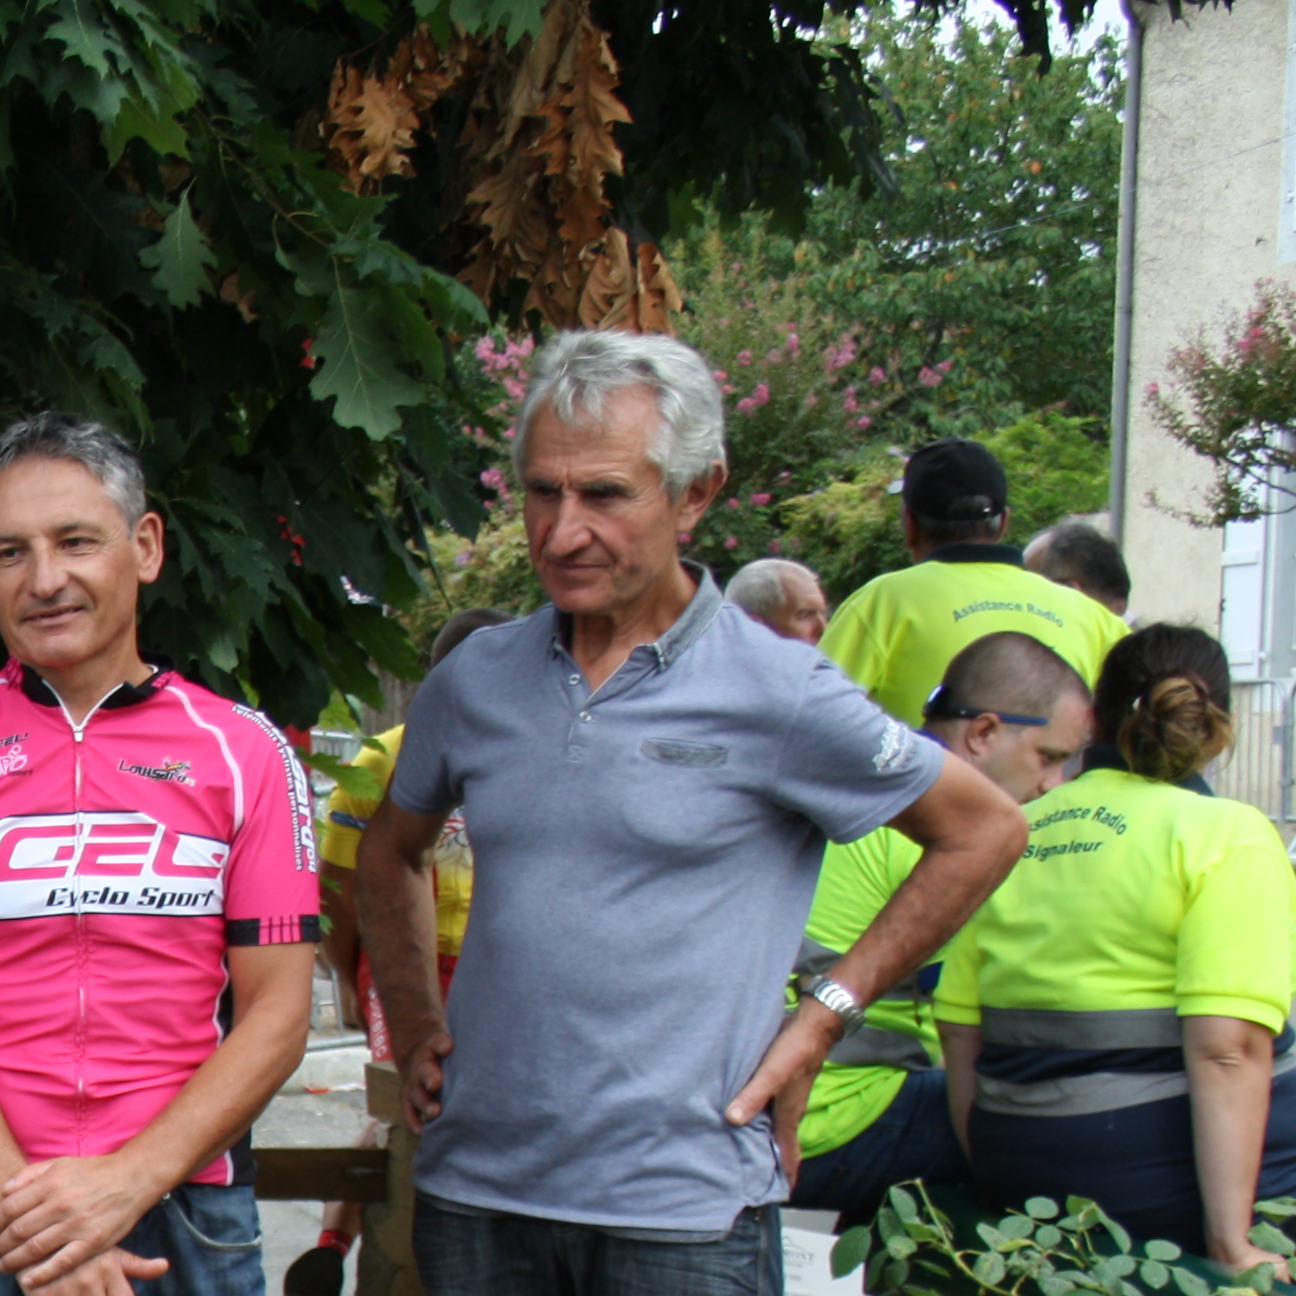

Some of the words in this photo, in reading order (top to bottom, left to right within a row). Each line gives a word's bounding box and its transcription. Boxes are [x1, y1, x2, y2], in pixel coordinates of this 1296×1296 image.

[952, 600, 1022, 622] Assistance
[1026, 601, 1064, 628] Radio
[1092, 806, 1128, 836] Radio
[1021, 840, 1104, 862] Signaleur
[45, 886, 130, 909] Cyclo
[136, 886, 215, 910] Sport
